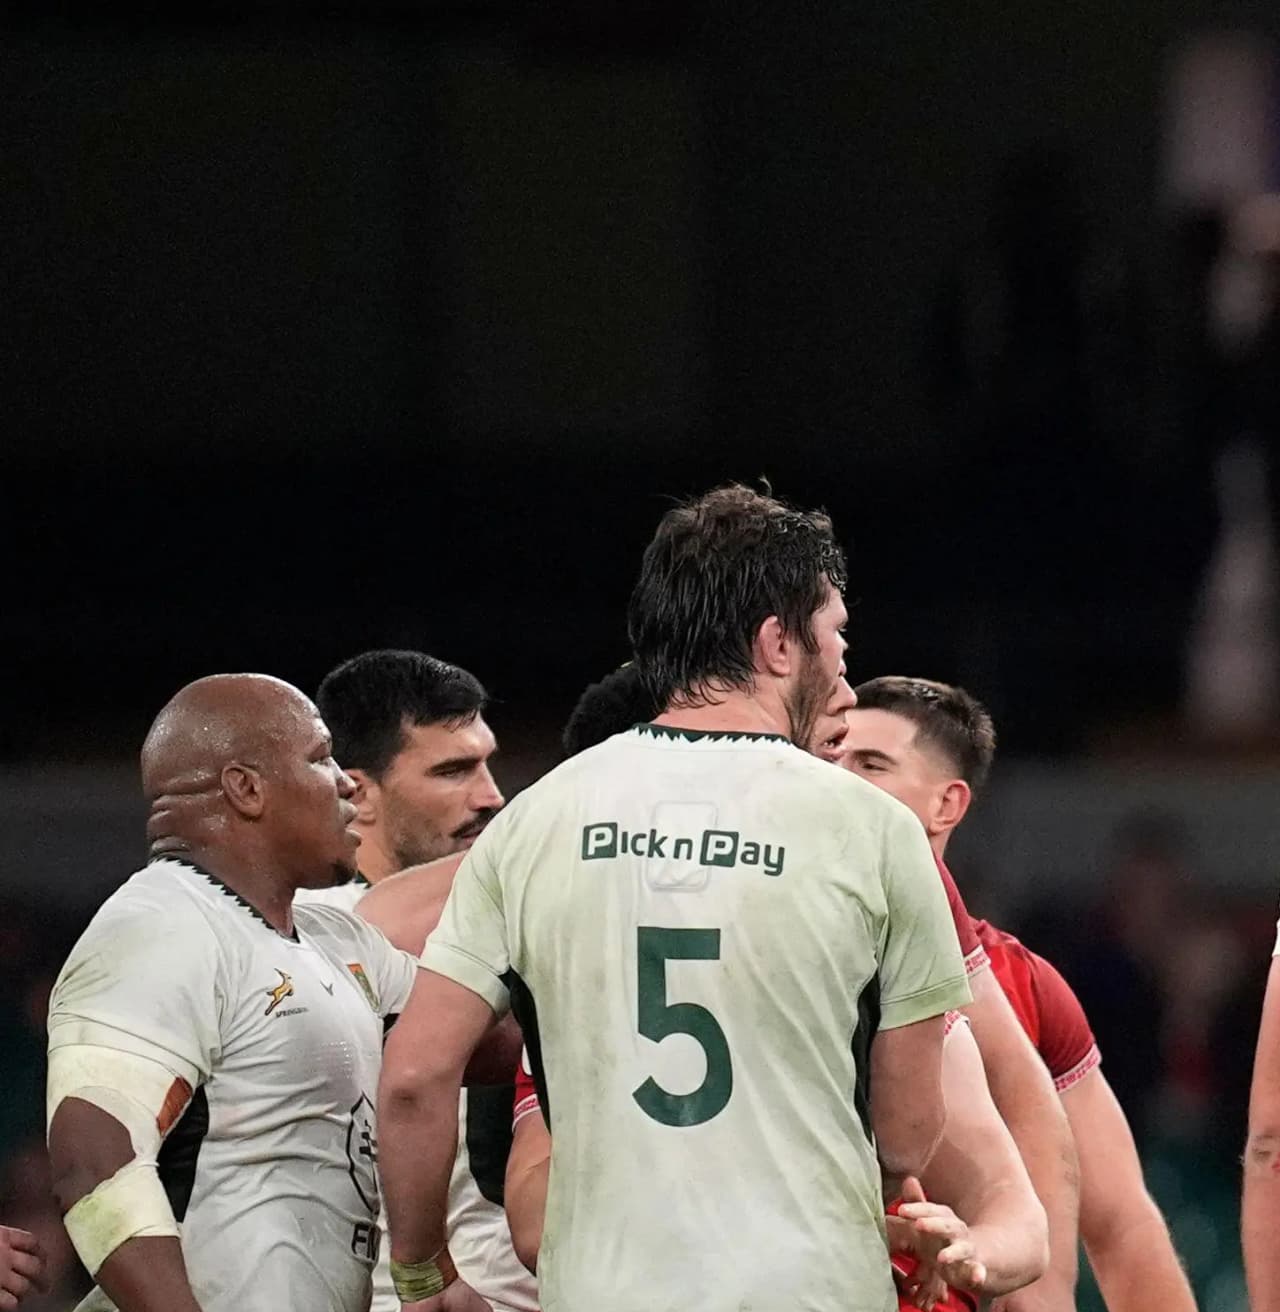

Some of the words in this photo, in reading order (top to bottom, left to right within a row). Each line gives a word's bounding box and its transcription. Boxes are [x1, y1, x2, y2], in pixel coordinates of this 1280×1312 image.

[581, 822, 668, 860] Pick
[673, 837, 694, 861] n
[699, 829, 786, 877] Pay
[631, 925, 734, 1128] 5
